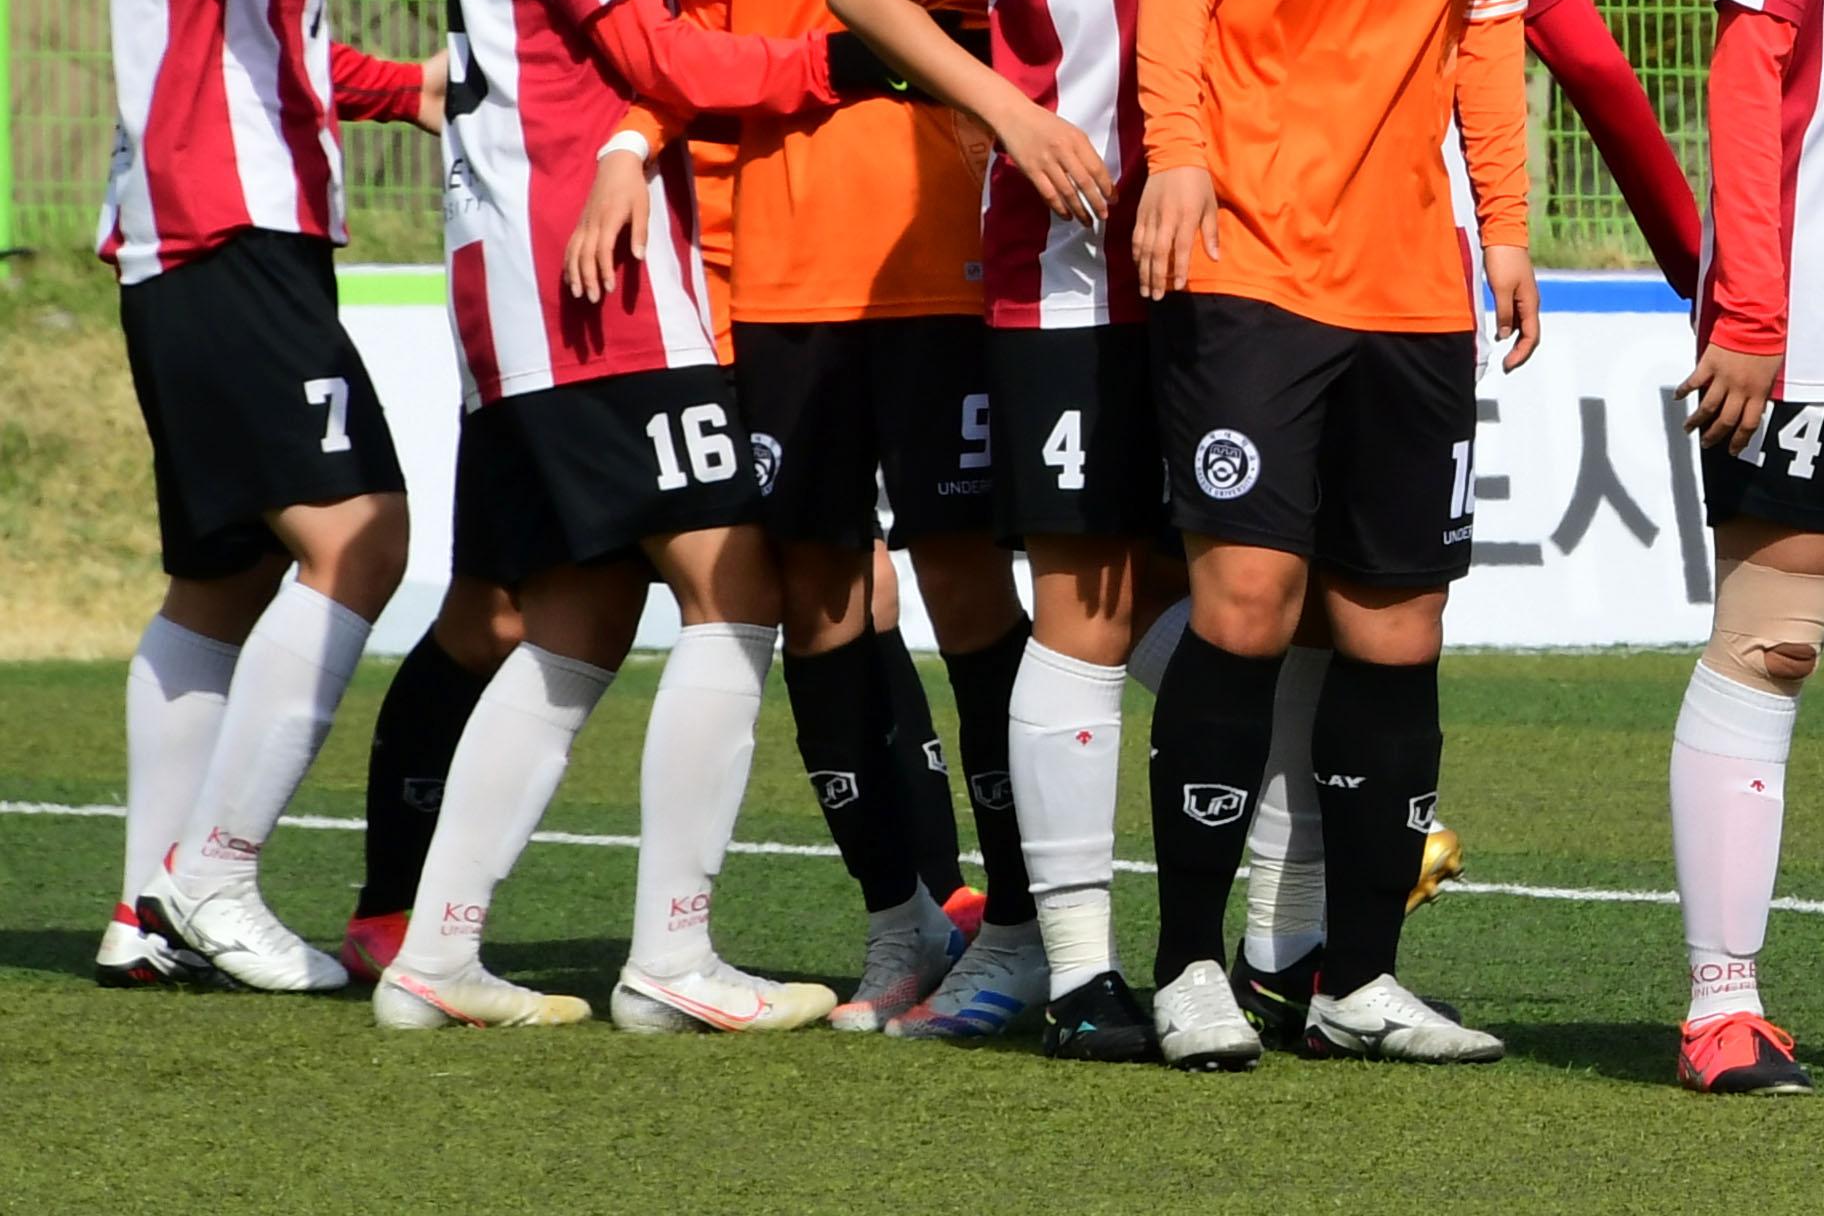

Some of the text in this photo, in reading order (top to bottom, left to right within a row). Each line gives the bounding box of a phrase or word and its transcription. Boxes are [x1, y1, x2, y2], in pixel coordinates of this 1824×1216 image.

[304, 377, 351, 453] 7
[646, 403, 737, 491] 16
[1042, 410, 1086, 490] 4
